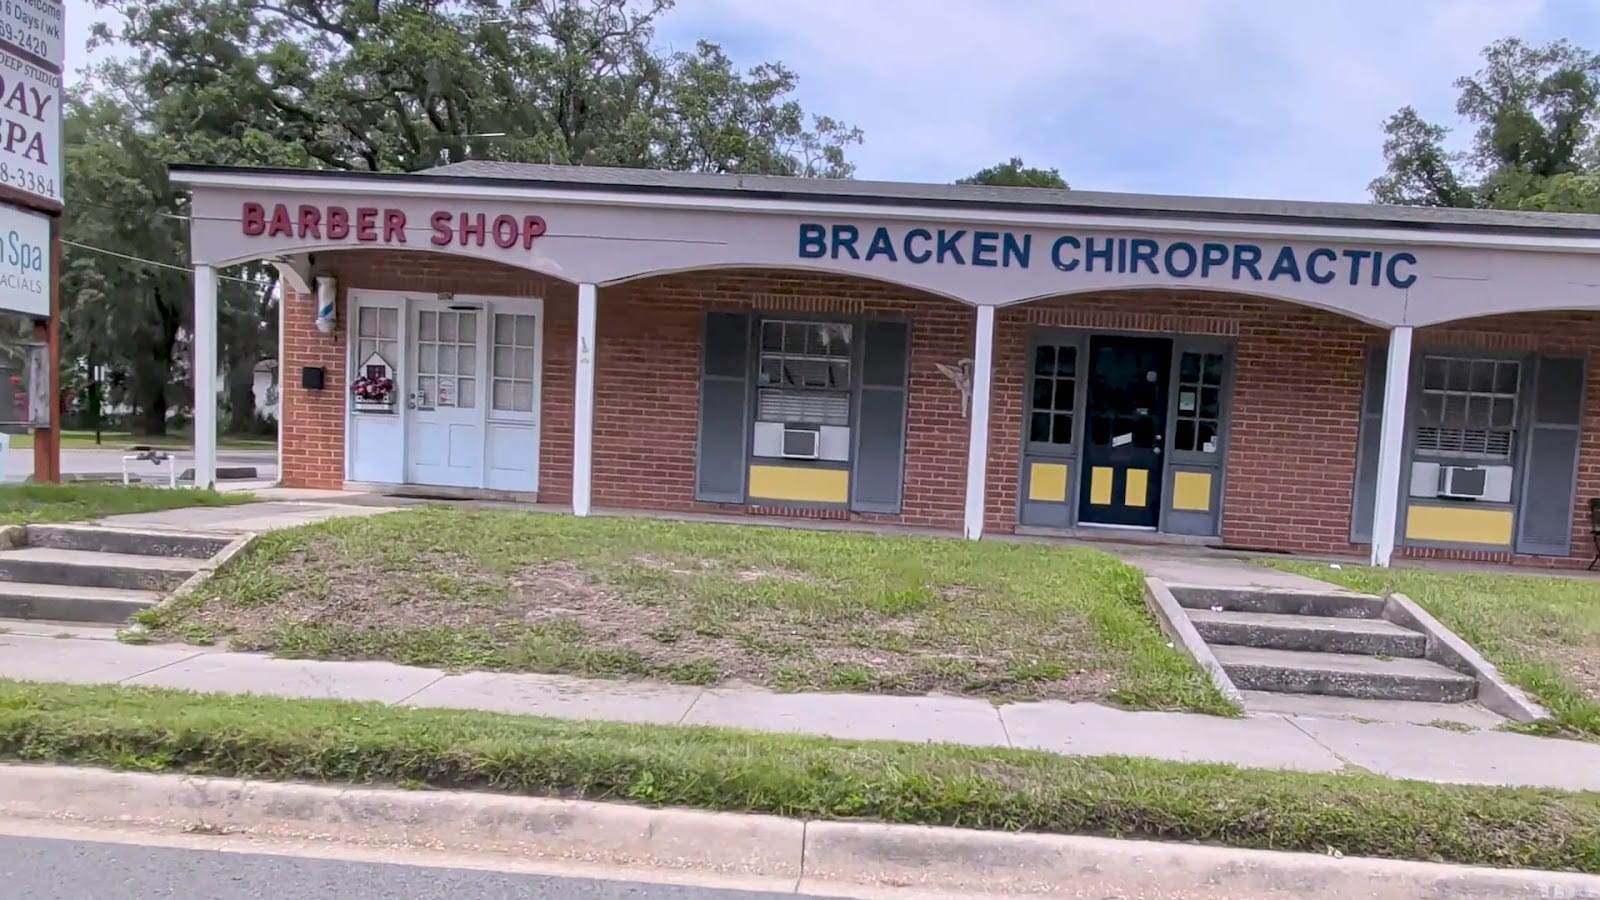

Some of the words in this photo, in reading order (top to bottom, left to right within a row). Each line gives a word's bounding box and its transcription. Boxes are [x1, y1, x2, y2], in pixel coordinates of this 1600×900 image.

[15, 4, 60, 40] Days/wk
[24, 0, 61, 20] elcome
[0, 74, 52, 122] AY
[24, 64, 60, 89] STUDIO
[0, 117, 48, 165] PA
[242, 202, 407, 243] BARBER
[430, 211, 547, 250] SHOP
[9, 230, 42, 275] Spa
[799, 223, 1032, 269] BRACKEN
[1051, 235, 1418, 289] CHIROPRACTIC
